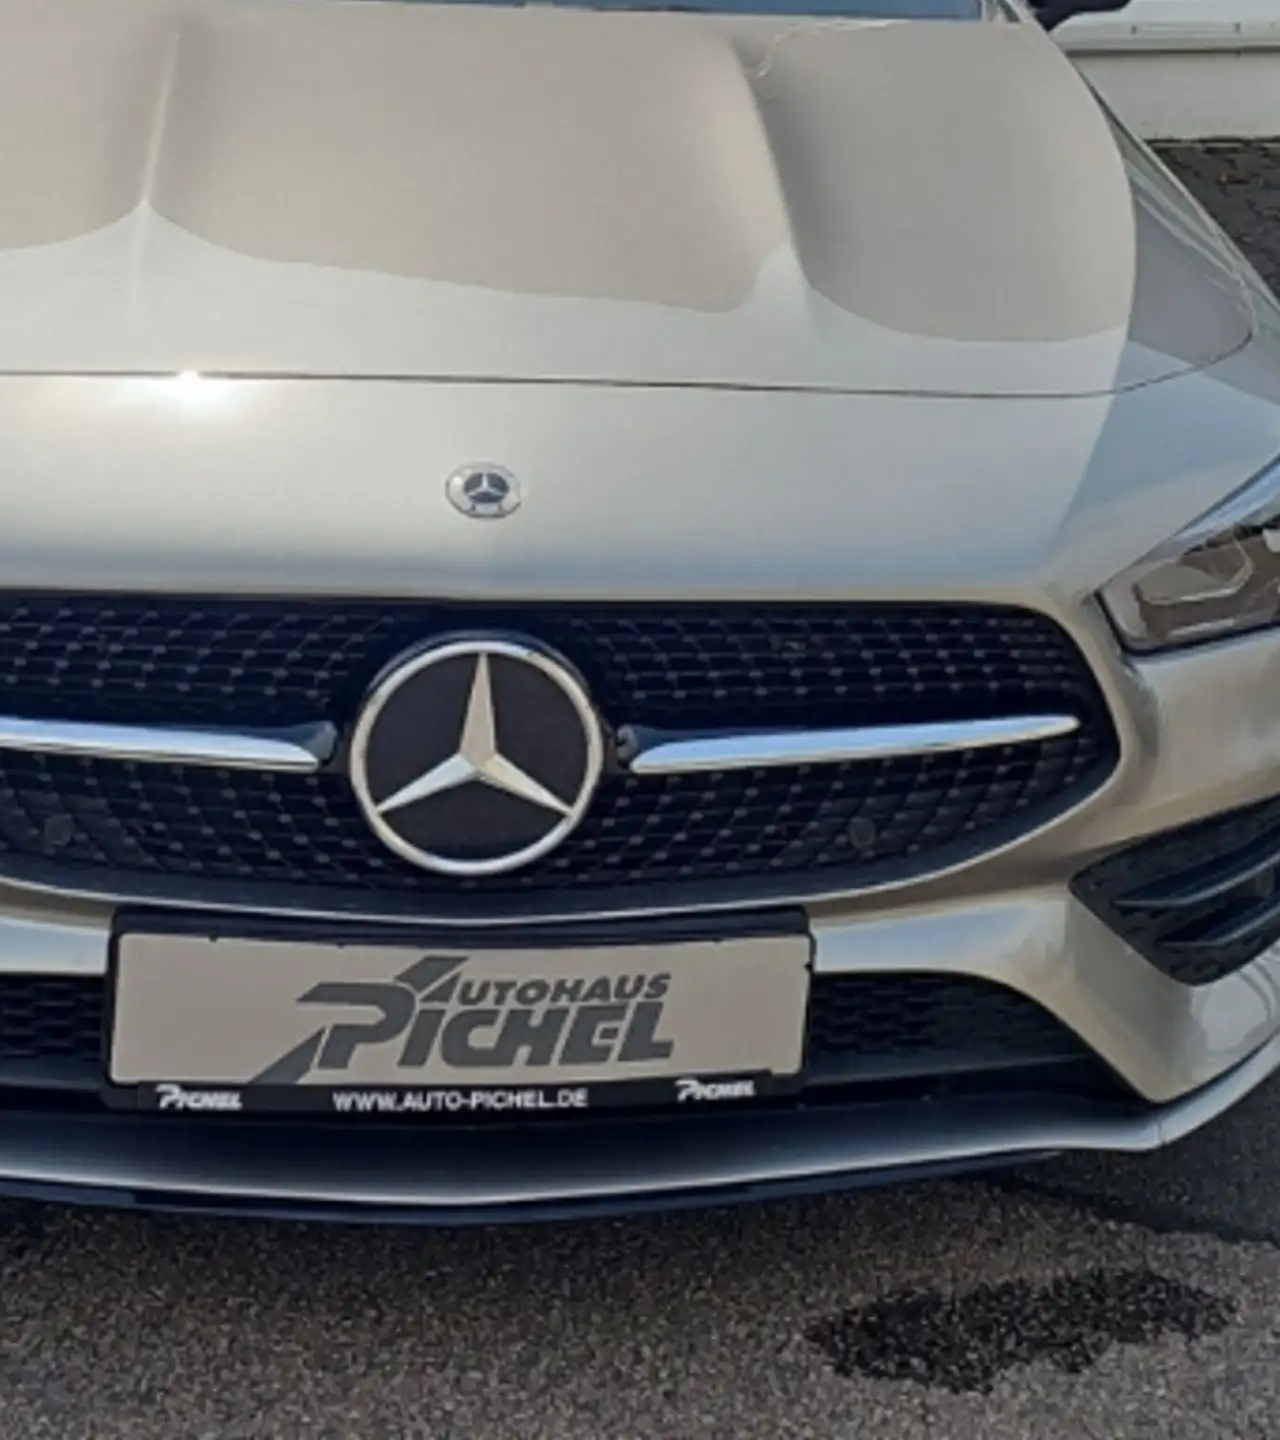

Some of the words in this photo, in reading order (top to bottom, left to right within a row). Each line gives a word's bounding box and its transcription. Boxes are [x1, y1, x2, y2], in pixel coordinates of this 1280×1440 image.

[420, 971, 672, 1008] AUTOHAUS
[296, 981, 676, 1070] PICHEL
[155, 1083, 244, 1112] PICHEL
[331, 1087, 589, 1113] WWW.AUTO-PICHEL.DE
